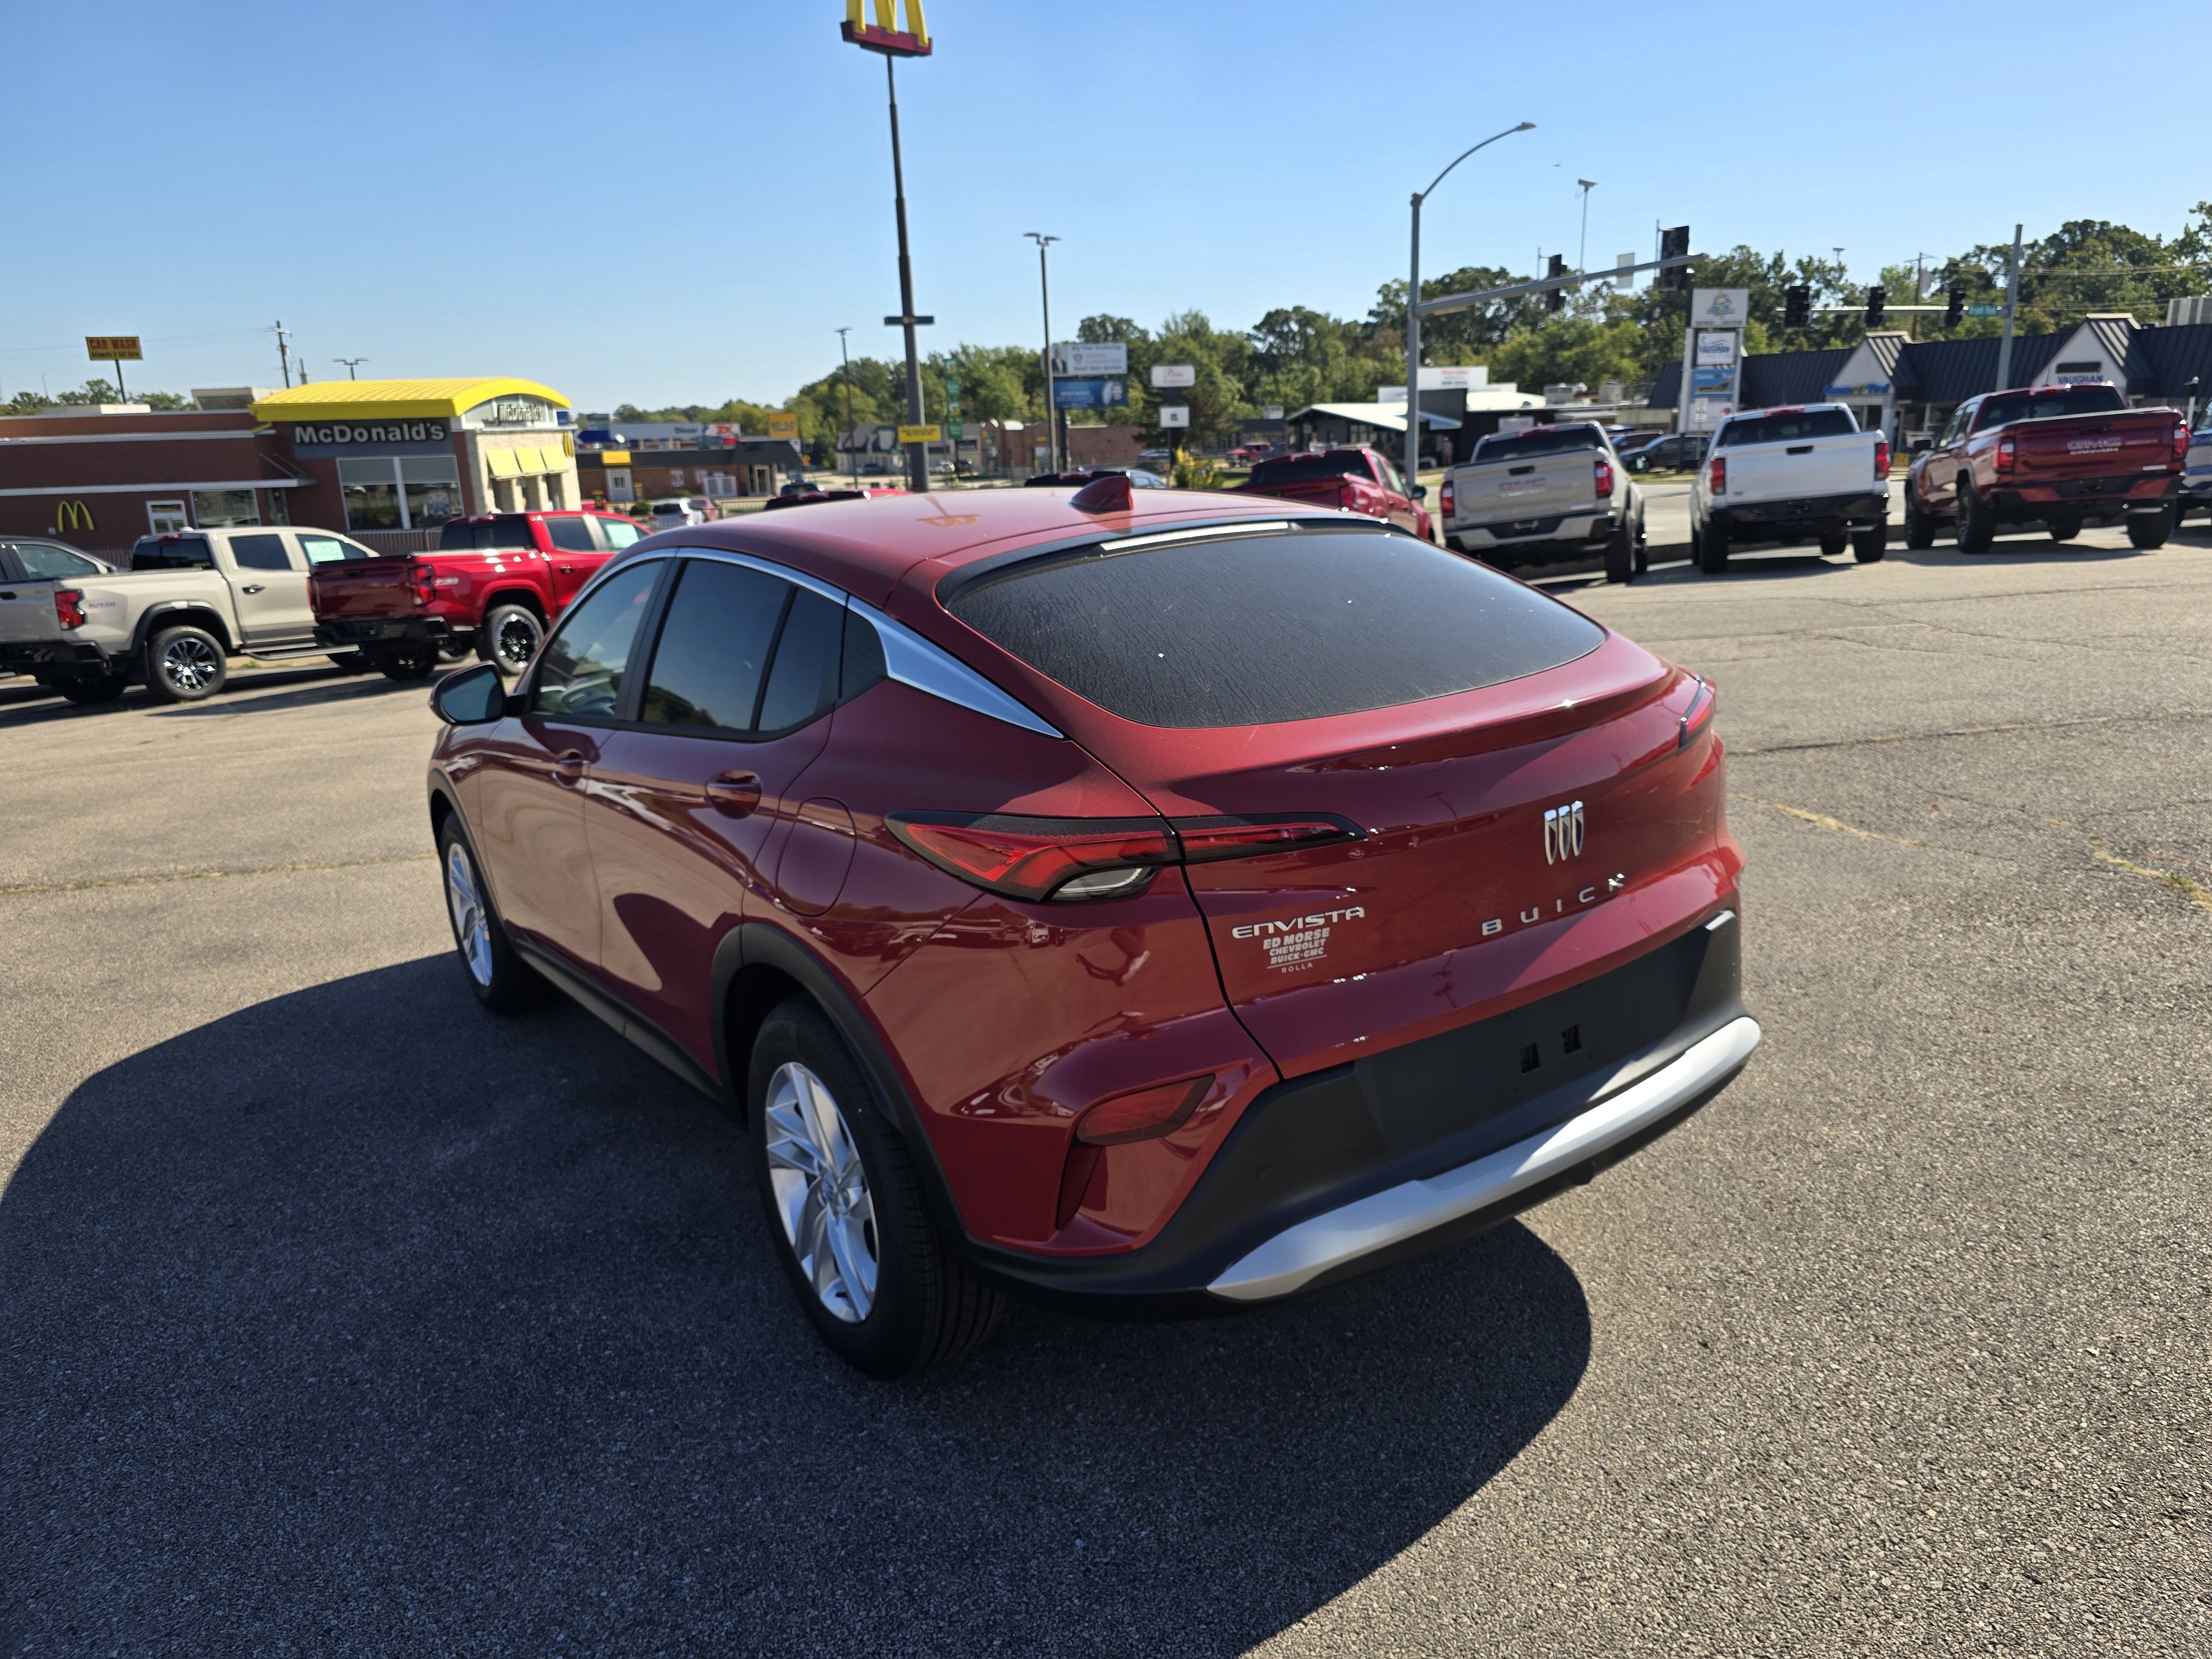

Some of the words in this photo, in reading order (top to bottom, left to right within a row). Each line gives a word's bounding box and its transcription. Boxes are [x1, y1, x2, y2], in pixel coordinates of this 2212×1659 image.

[89, 338, 108, 349] CAR
[111, 338, 138, 349] WASH
[294, 422, 445, 444] McDonald's
[1481, 873, 1625, 936] BUICK
[1263, 937, 1281, 950] ED
[1284, 927, 1331, 945] MORSE
[1269, 938, 1327, 957] CHEVROLET
[1281, 962, 1313, 974] ROLLA
